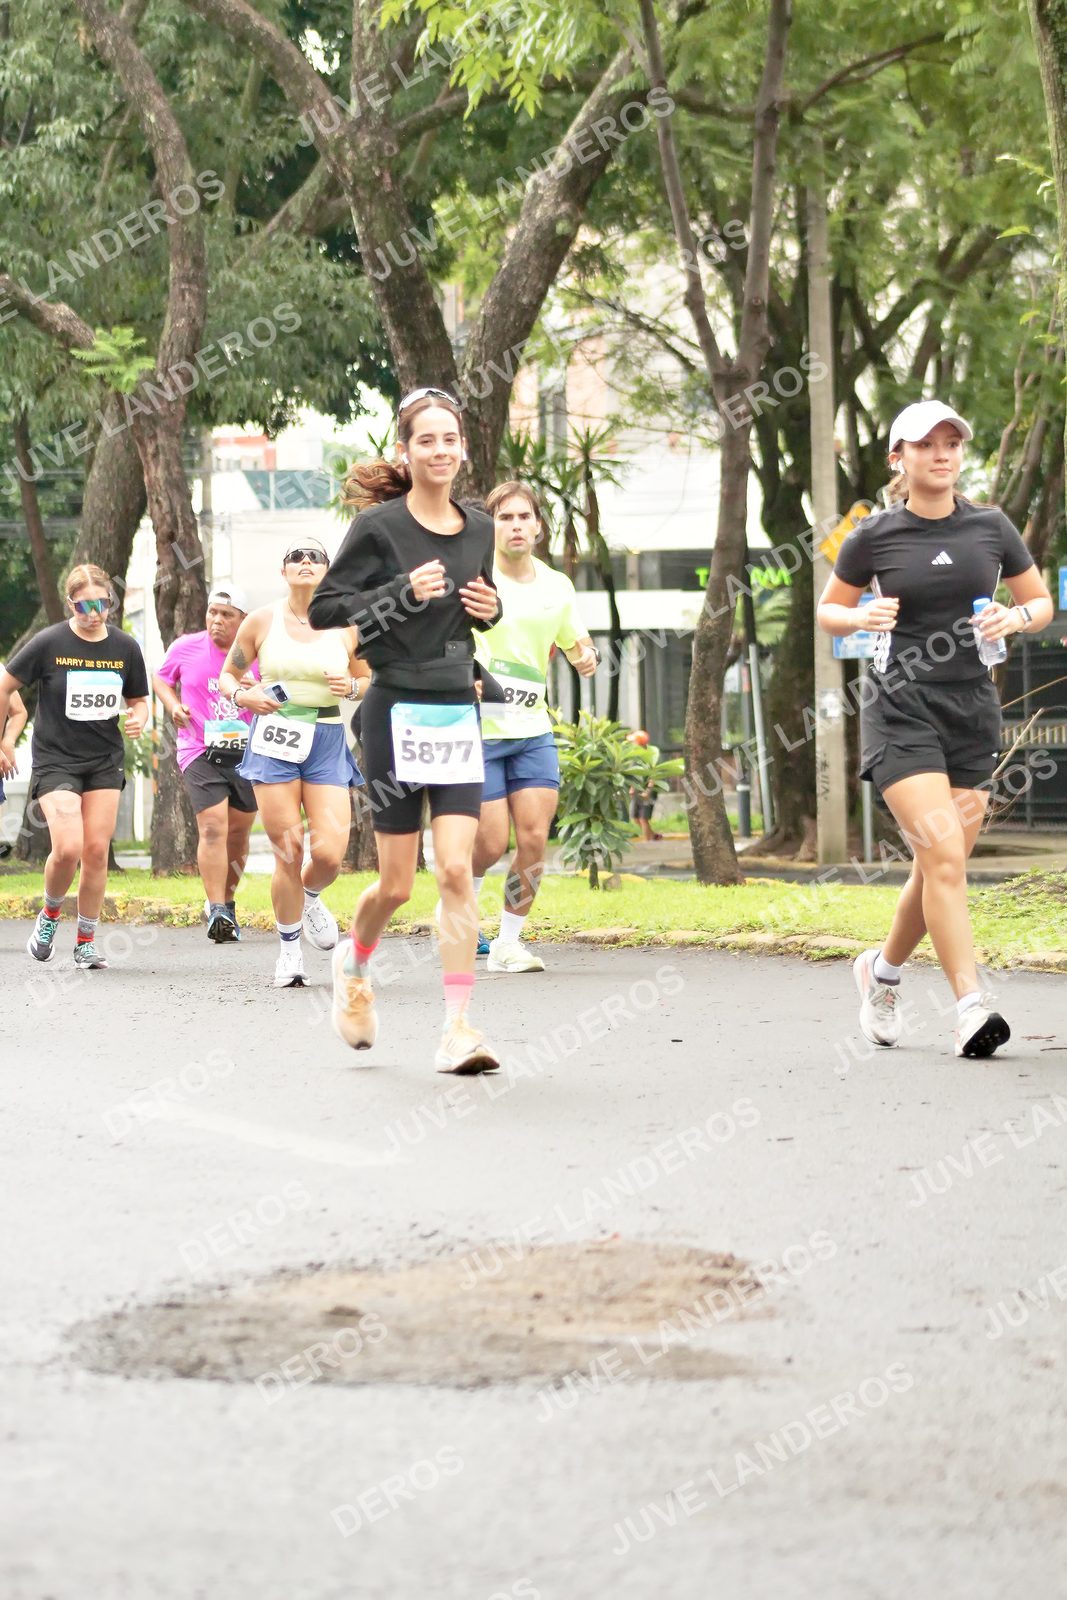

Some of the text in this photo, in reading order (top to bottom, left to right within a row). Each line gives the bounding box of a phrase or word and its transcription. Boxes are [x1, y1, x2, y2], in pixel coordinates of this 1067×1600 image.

[56, 657, 83, 667] HARRY
[96, 660, 124, 669] STYLES
[70, 693, 117, 708] 5580
[262, 725, 302, 749] 652
[401, 739, 474, 764] 5877
